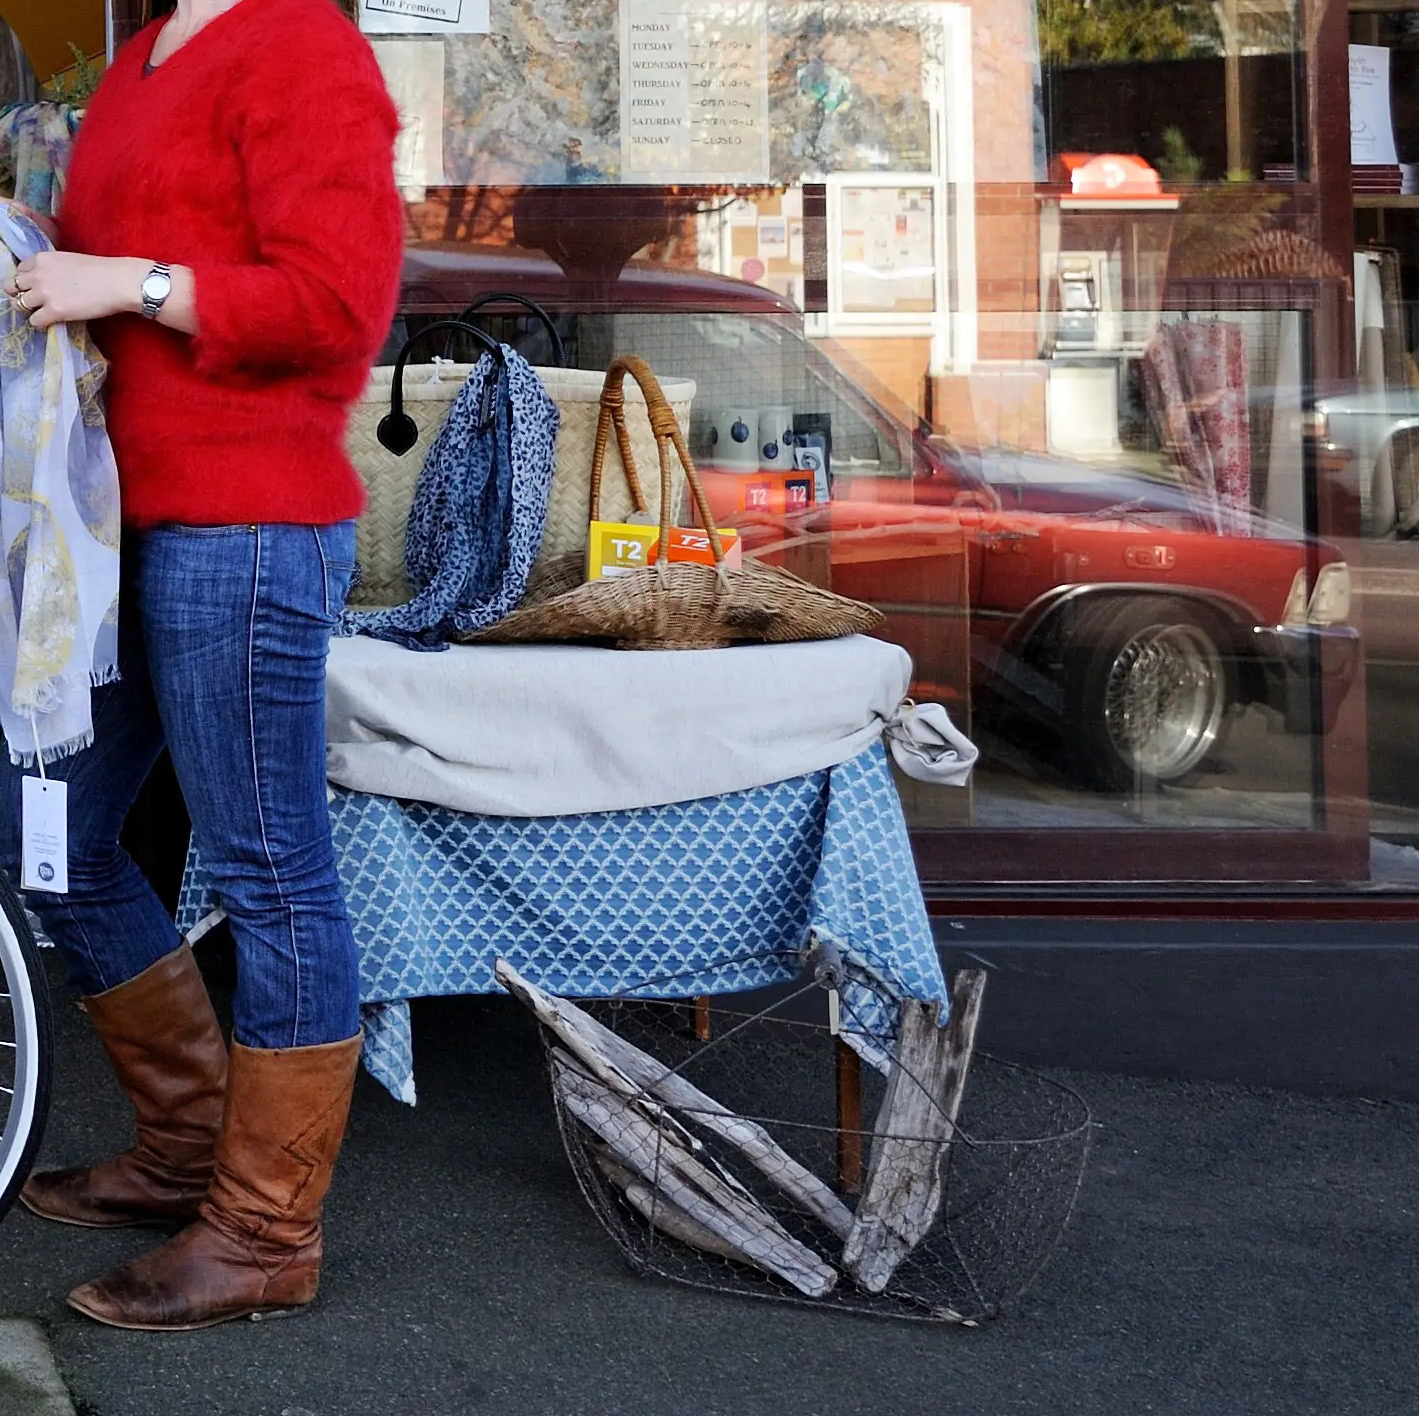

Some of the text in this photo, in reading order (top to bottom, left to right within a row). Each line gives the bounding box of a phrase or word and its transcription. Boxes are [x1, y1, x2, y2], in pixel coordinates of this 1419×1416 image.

[399, 0, 446, 15] Premises
[631, 24, 672, 32] MONDAY
[632, 42, 674, 51] TUESDAY
[631, 61, 690, 69] WEDNESDAY
[632, 80, 681, 88] THURSDAY
[632, 99, 666, 107] FRIDAY
[631, 117, 682, 126] SATURDAY
[632, 136, 742, 145] SUNDAY CLOSED
[750, 488, 767, 506] T2
[790, 485, 807, 503] T2
[680, 534, 711, 549] T2
[611, 538, 643, 561] T2
